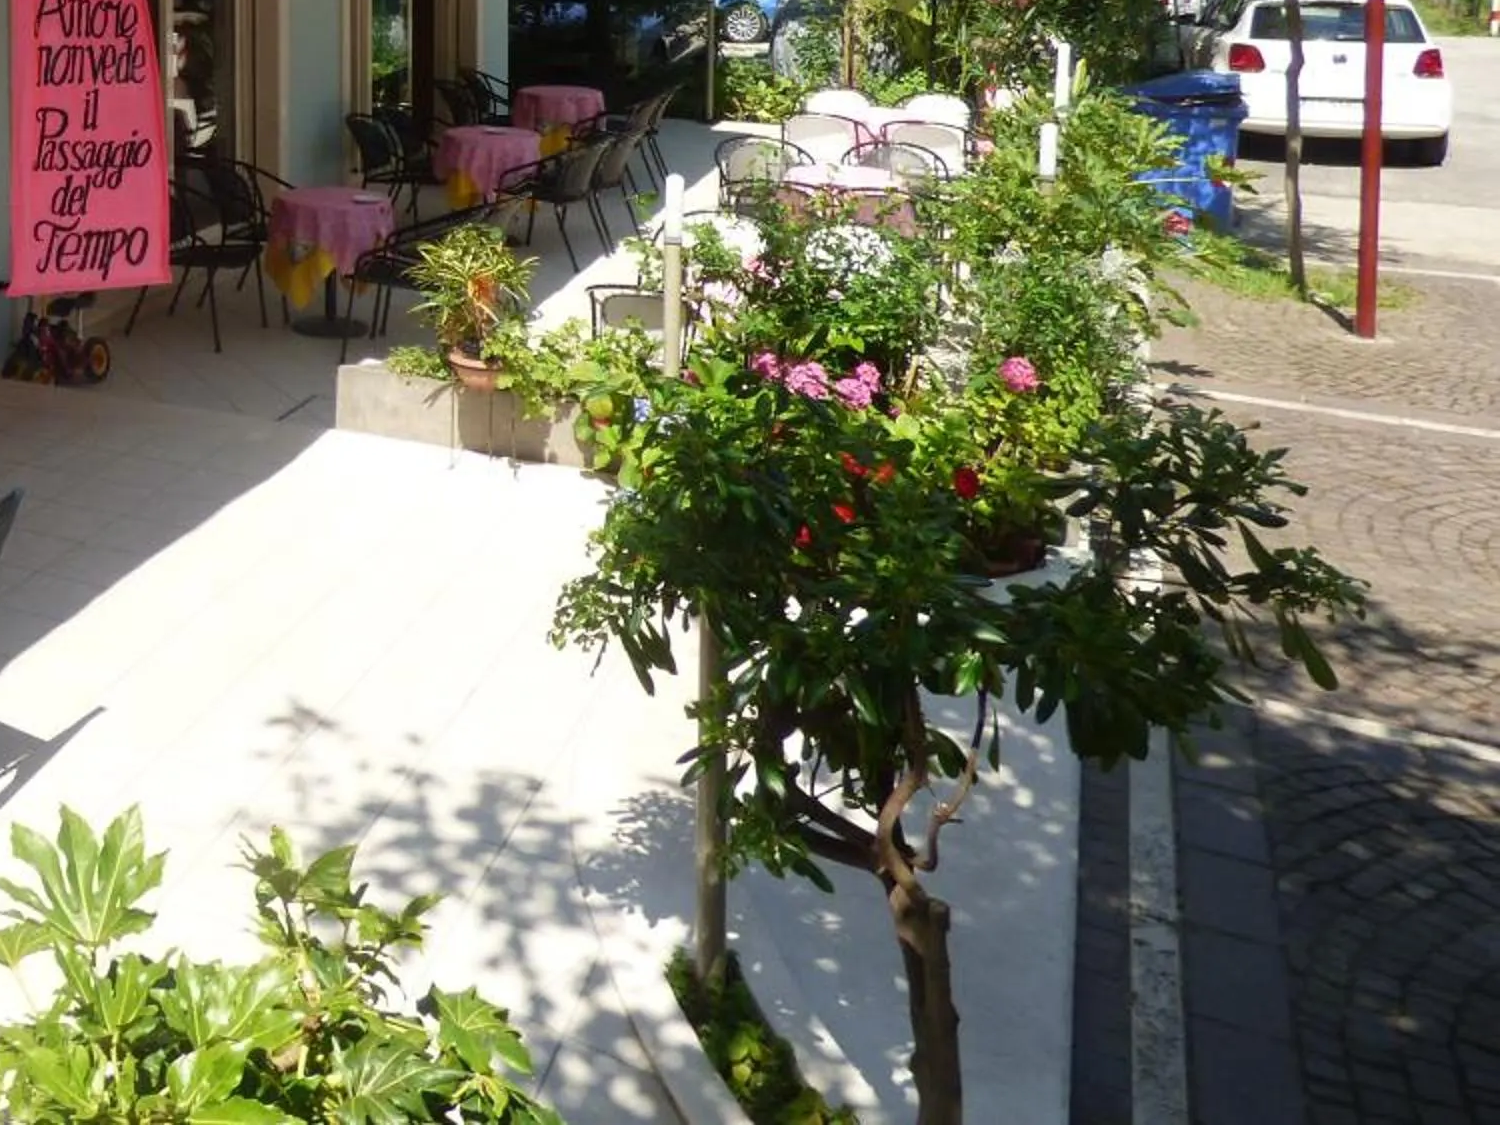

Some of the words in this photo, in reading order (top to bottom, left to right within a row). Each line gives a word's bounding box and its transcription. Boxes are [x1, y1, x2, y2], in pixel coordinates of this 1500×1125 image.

[83, 88, 99, 131] il
[33, 107, 153, 190] Passaggio
[51, 174, 92, 217] del
[33, 217, 149, 282] Tempo
